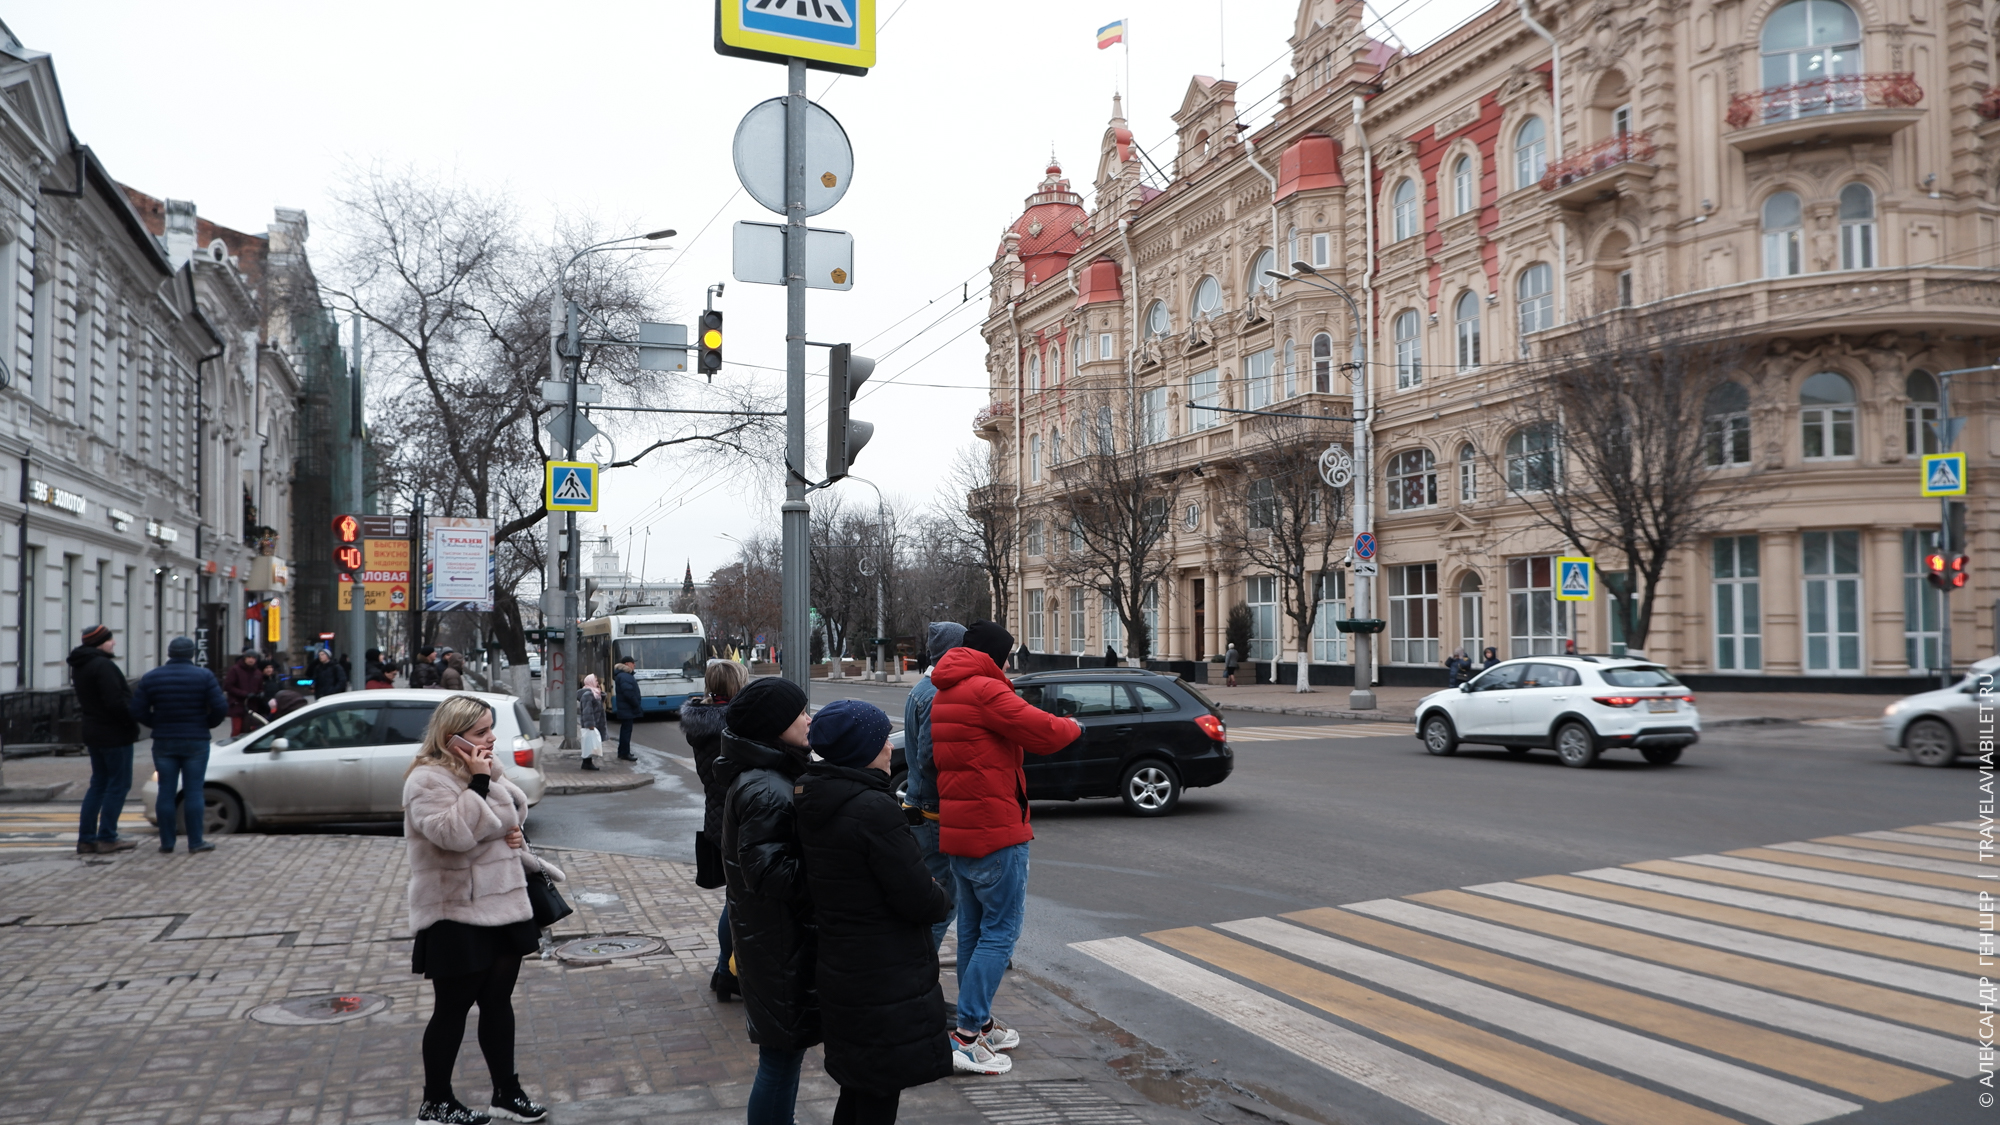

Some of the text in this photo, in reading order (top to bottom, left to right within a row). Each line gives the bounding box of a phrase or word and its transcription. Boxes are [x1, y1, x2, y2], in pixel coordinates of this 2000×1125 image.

[34, 480, 86, 514] 585 ЗОЛОТОЙ
[341, 549, 360, 568] 40
[342, 572, 408, 582] СЛОВАЯ
